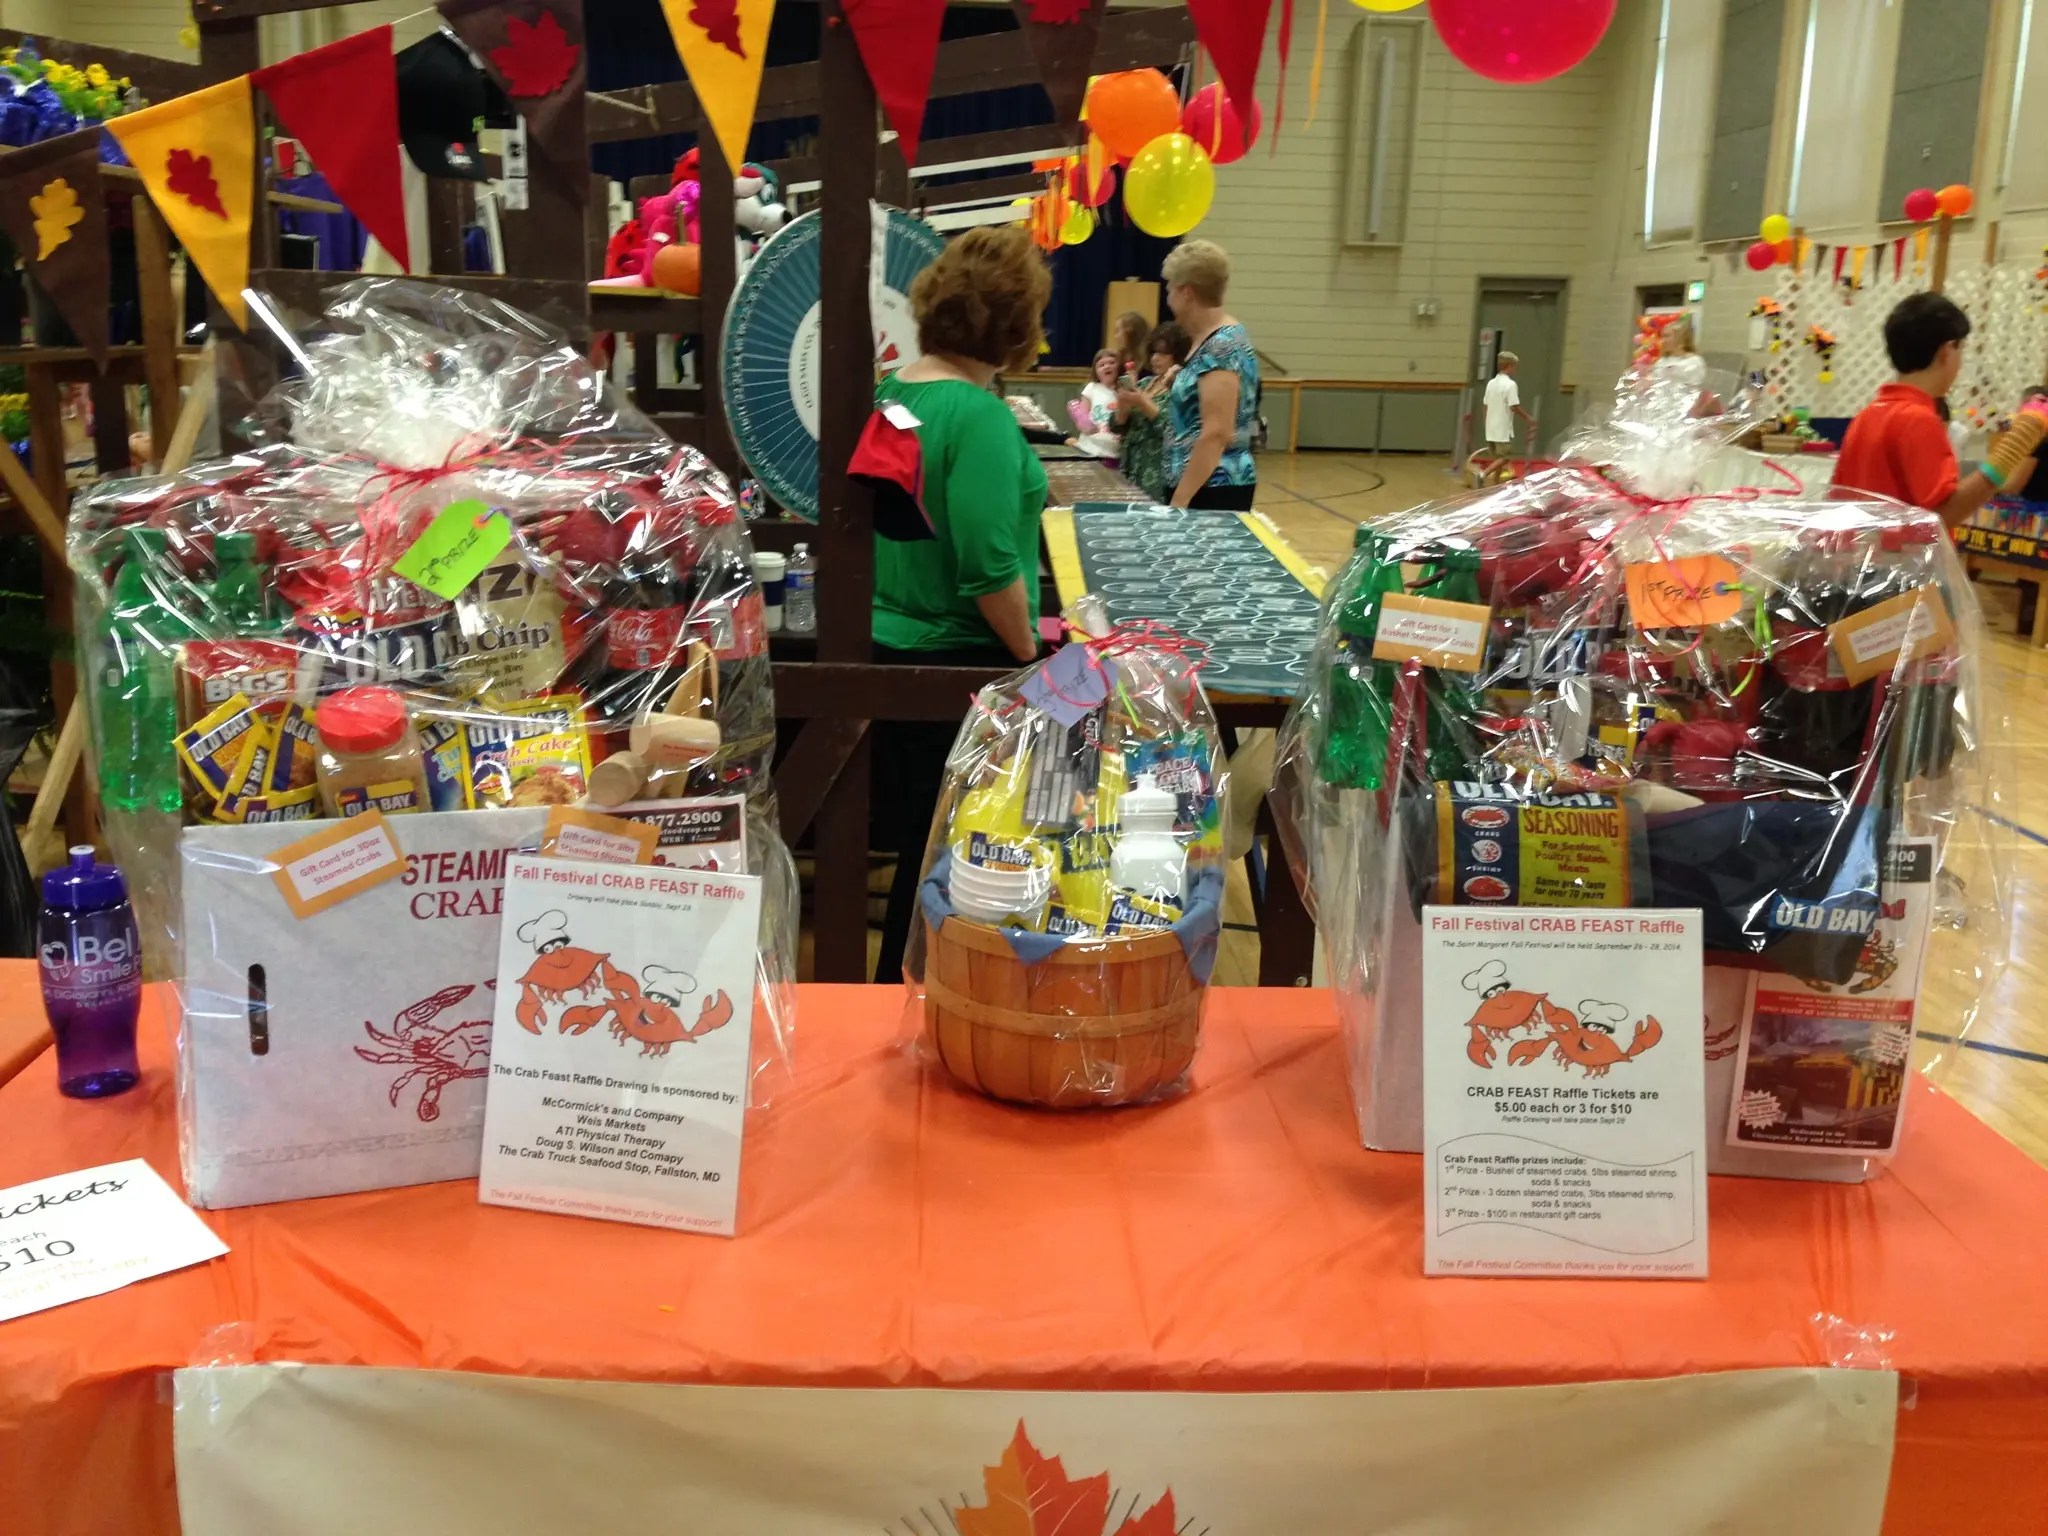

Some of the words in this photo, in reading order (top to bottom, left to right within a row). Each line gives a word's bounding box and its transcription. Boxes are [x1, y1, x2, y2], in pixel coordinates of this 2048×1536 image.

[380, 794, 413, 811] BAY
[1522, 808, 1619, 838] SEASONING
[580, 834, 601, 848] Card
[972, 840, 1000, 859] OLD
[513, 865, 539, 880] Fall
[543, 868, 598, 886] Festival
[601, 873, 645, 890] CRAB
[650, 878, 699, 895] FEAST
[703, 883, 746, 900] Raffle
[1111, 902, 1139, 923] OLD
[1775, 901, 1825, 931] OLD
[1827, 907, 1876, 933] BAY
[1431, 917, 1460, 931] Fall
[1464, 917, 1525, 932] Festival
[1529, 918, 1577, 933] CRAB
[1581, 919, 1635, 933] FEAST
[1639, 919, 1686, 934] Raffle
[78, 926, 134, 967] Bel
[1442, 940, 1456, 948] The
[1477, 940, 1509, 950] Margaret
[1525, 941, 1552, 949] Festival
[1594, 942, 1632, 951] September
[80, 961, 132, 985] Smile
[493, 1064, 512, 1076] The
[514, 1067, 540, 1079] Crab
[541, 1069, 571, 1082] Feast
[573, 1073, 603, 1086] Raffle
[605, 1077, 648, 1094] Drawing
[651, 1083, 660, 1093] is
[663, 1086, 720, 1101] sponsored
[722, 1091, 739, 1105] by:
[1466, 1086, 1504, 1098] CRAB
[1507, 1087, 1550, 1098] FEAST
[1553, 1087, 1588, 1099] Raffle
[1591, 1088, 1636, 1100] Tickets
[1639, 1091, 1659, 1100] are
[541, 1097, 609, 1114] McCormick's
[611, 1107, 632, 1117] and
[633, 1108, 685, 1126] Company
[1494, 1102, 1526, 1113] $5.00
[1529, 1103, 1559, 1113] each
[1562, 1105, 1576, 1113] or
[1579, 1103, 1587, 1113] 3
[1589, 1103, 1607, 1113] for
[1610, 1103, 1632, 1114] $10
[576, 1114, 603, 1127] Weis
[604, 1117, 646, 1133] Markets
[1501, 1115, 1522, 1123] Raffle
[1522, 1116, 1550, 1124] Drawing
[1579, 1117, 1598, 1125] place
[1599, 1117, 1614, 1125] Sept
[555, 1126, 574, 1137] ATI
[575, 1128, 621, 1142] Physical
[623, 1133, 667, 1150] Therapy
[535, 1136, 564, 1151] Doug
[566, 1140, 576, 1150] S.
[579, 1142, 615, 1156] Wilson
[617, 1148, 638, 1158] and
[639, 1149, 684, 1166] Comapy
[1444, 1155, 1466, 1163] Crab
[1468, 1156, 1492, 1164] Feast
[1494, 1156, 1520, 1164] Raffle
[1522, 1157, 1549, 1165] prizes
[1551, 1157, 1587, 1165] include:
[499, 1144, 518, 1156] The
[520, 1147, 545, 1160] Crab
[547, 1150, 577, 1164] Truck
[578, 1155, 623, 1170] Seafood
[624, 1161, 652, 1175] Stop,
[654, 1164, 700, 1181] Fallston,
[702, 1171, 721, 1182] MD
[1444, 1164, 1455, 1173] 1st
[1457, 1166, 1478, 1174] Prize
[1486, 1166, 1514, 1175] Bushel
[1516, 1167, 1525, 1175] of
[1526, 1167, 1562, 1175] steamed
[1591, 1168, 1609, 1176] 5lbs
[1611, 1168, 1647, 1177] steamed
[1444, 1186, 1457, 1196] 2nd
[1458, 1188, 1480, 1196] Prize
[1487, 1188, 1494, 1196] 3
[1495, 1188, 1521, 1196] dozen
[1523, 1189, 1559, 1197] steamed
[1588, 1189, 1606, 1198] 3lbs
[1607, 1190, 1643, 1198] steamed
[1562, 1179, 1591, 1187] snacks
[0, 1179, 129, 1220] ickets
[1458, 1209, 1479, 1218] Prize
[1486, 1209, 1508, 1218] $100
[1509, 1210, 1517, 1218] in
[1519, 1211, 1561, 1219] restaurant
[1563, 1211, 1576, 1220] gift
[0, 1231, 47, 1247] each
